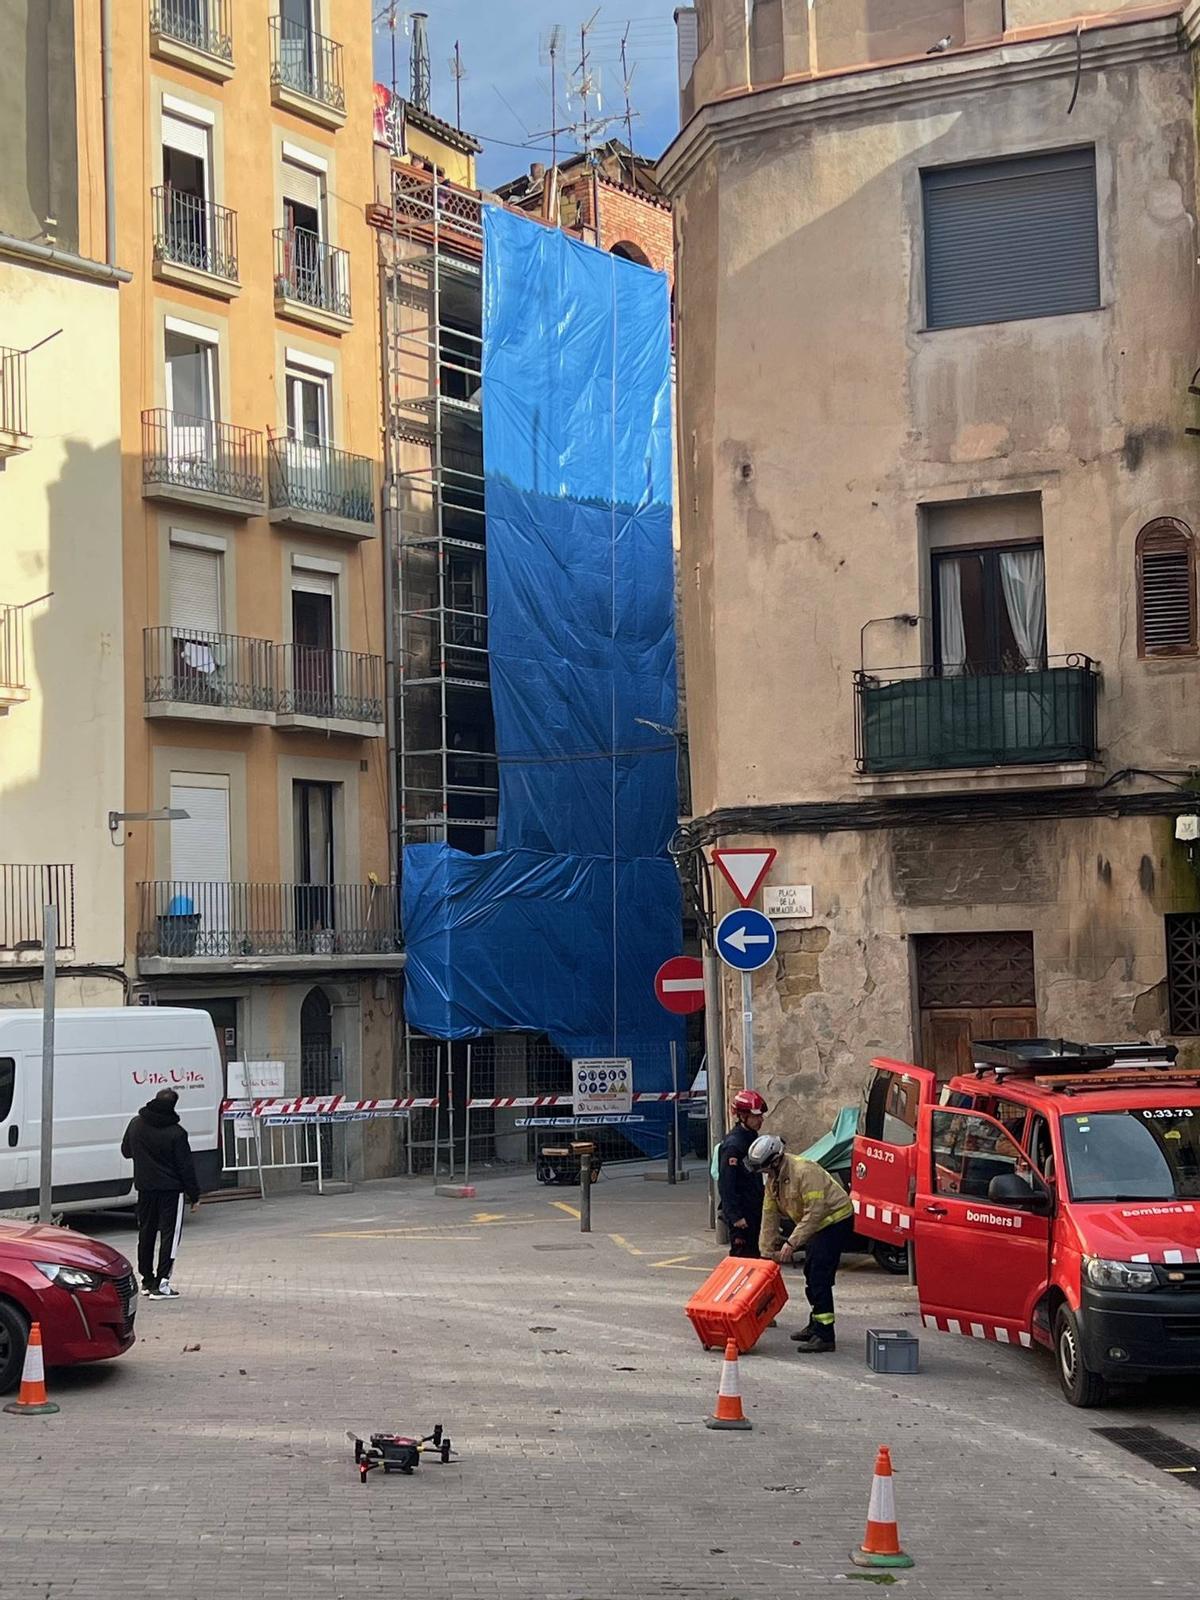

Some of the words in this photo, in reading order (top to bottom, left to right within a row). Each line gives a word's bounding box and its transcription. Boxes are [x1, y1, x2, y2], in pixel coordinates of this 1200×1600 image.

[1142, 1109, 1194, 1118] 0.33.73
[866, 1146, 894, 1163] 0.33.73
[966, 1209, 1012, 1227] bombers
[1121, 1207, 1183, 1217] bombers
